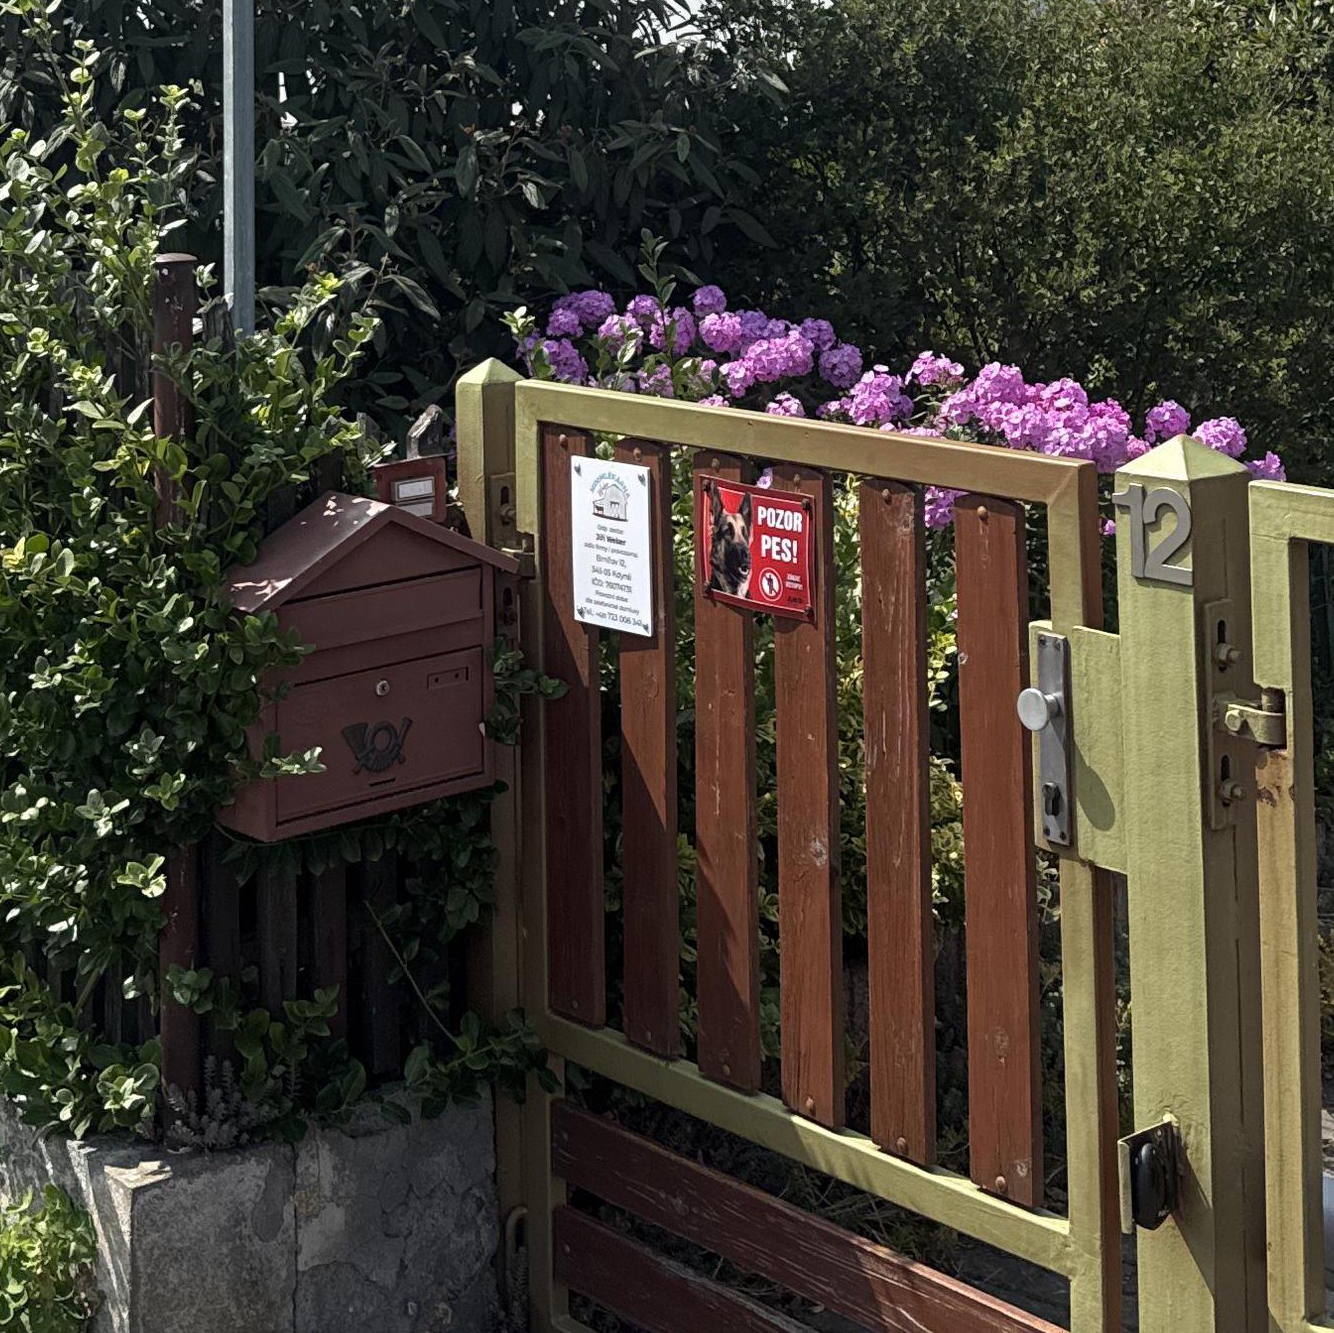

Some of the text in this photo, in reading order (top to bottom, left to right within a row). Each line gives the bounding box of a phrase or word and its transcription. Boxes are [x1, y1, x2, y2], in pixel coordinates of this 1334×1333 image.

[757, 505, 803, 533] POZOR
[1112, 482, 1193, 586] 12
[760, 534, 798, 564] PES!
